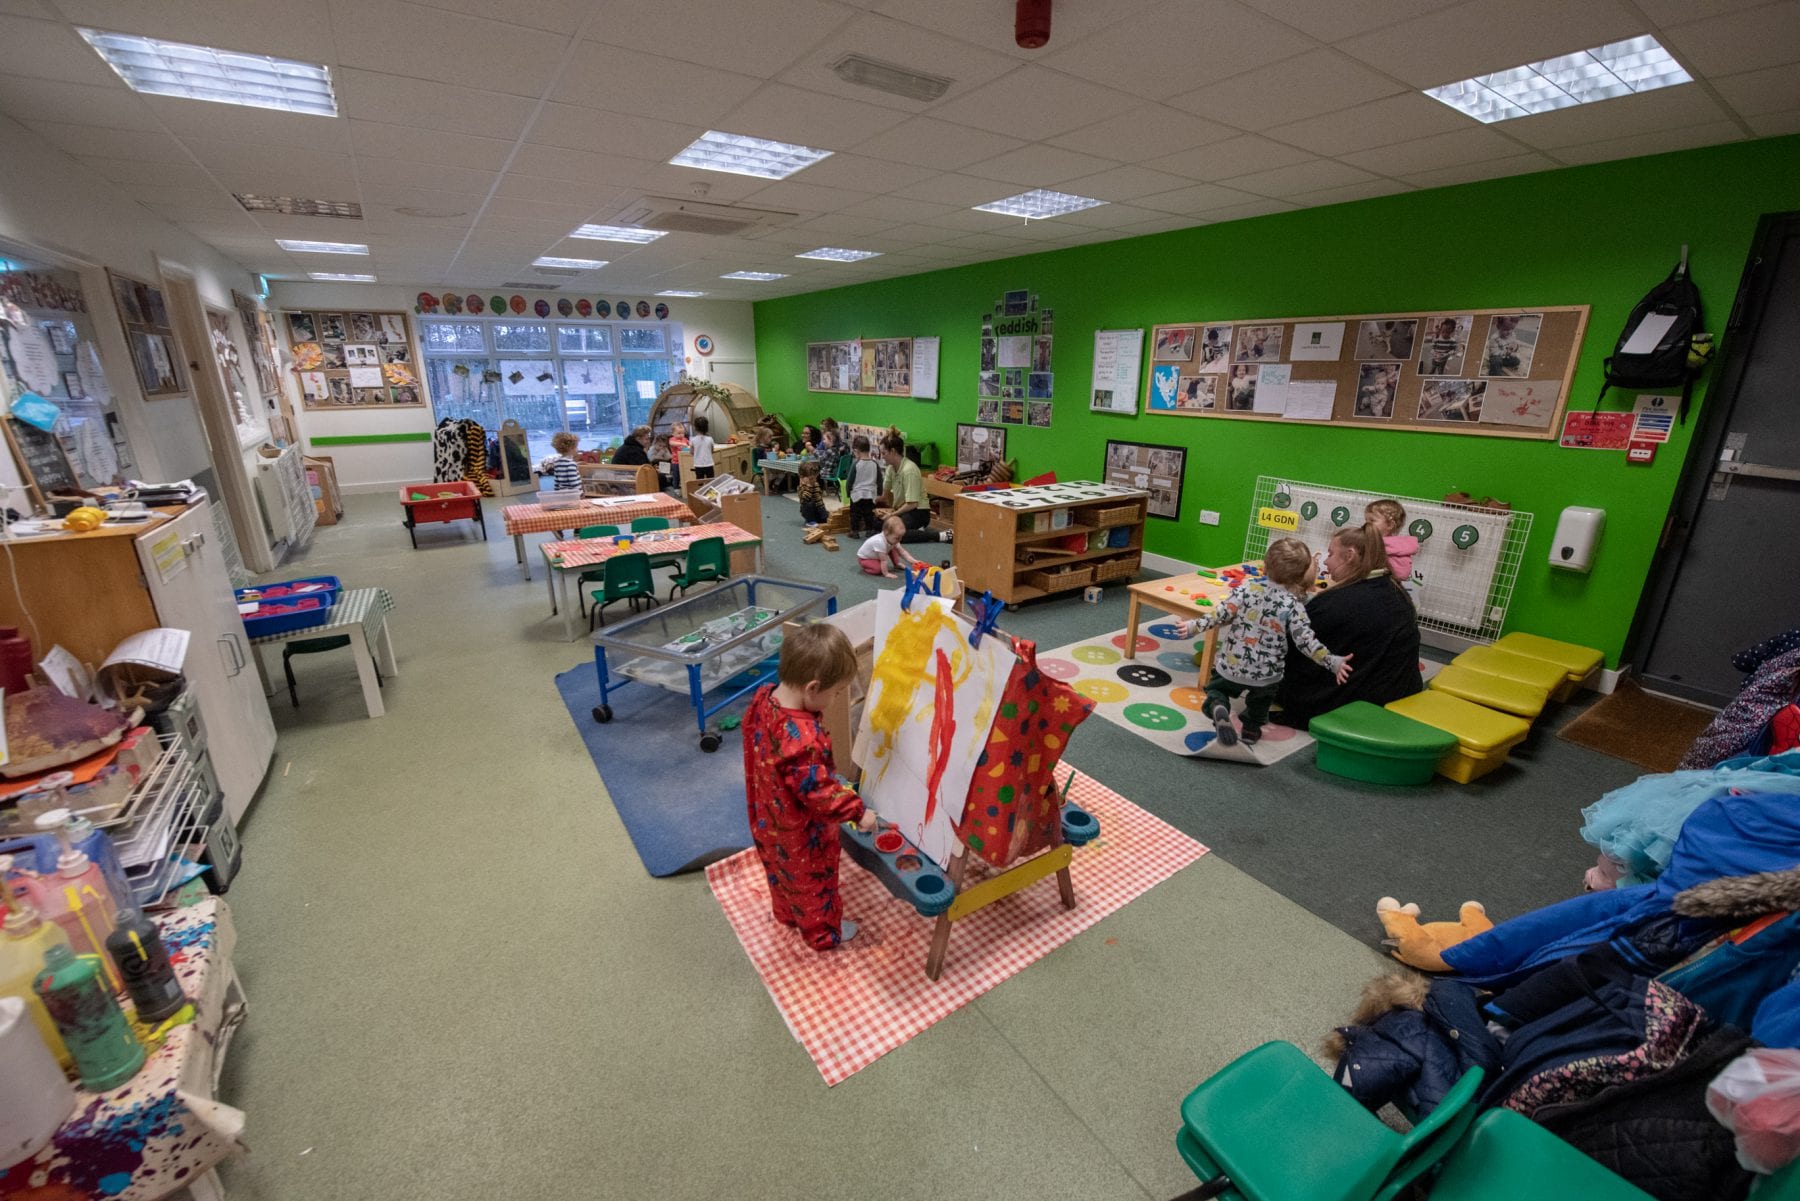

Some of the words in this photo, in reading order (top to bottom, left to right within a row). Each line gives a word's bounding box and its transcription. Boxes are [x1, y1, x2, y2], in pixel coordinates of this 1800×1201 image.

[994, 317, 1039, 337] reddish
[1261, 512, 1272, 521] L4
[1273, 514, 1296, 525] GDN
[1306, 505, 1312, 515] 1
[1336, 510, 1344, 521] 2
[1415, 524, 1425, 536] 4
[1459, 530, 1471, 542] 5
[1414, 570, 1424, 581] 4
